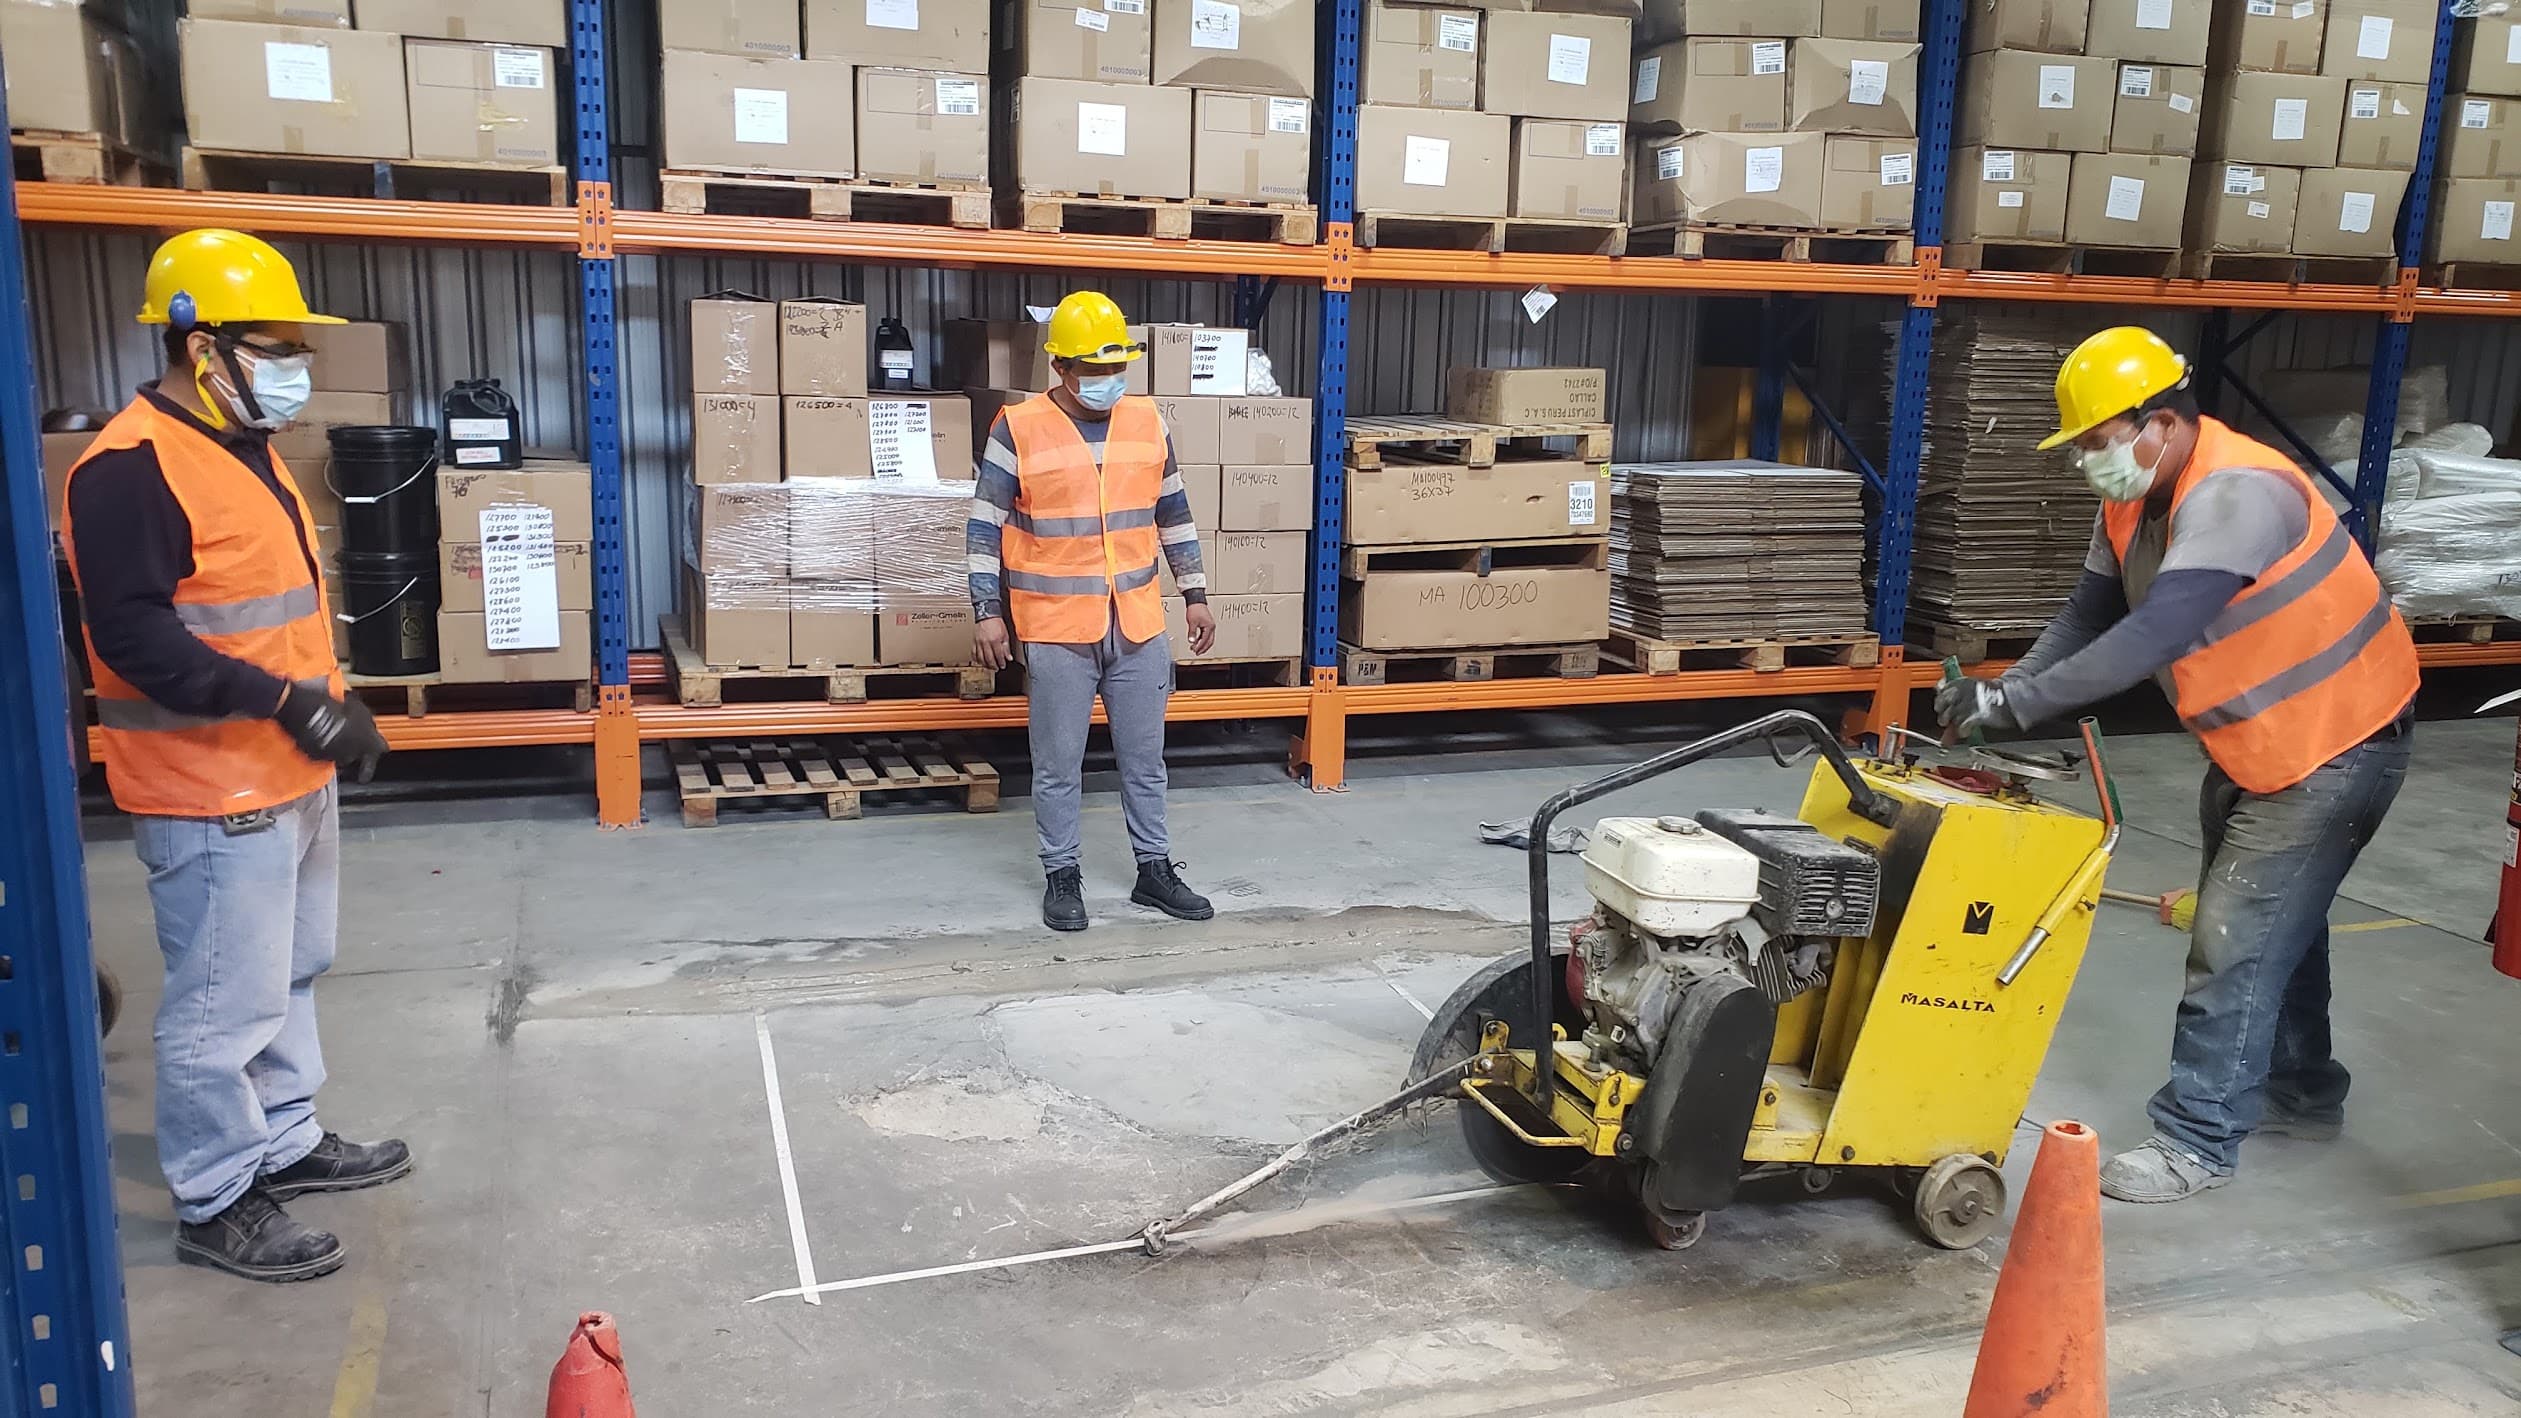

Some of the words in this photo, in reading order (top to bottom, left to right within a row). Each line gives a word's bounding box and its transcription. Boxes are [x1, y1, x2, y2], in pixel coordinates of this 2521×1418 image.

[1569, 392, 1597, 403] CALLAO
[1570, 498, 1593, 510] 3210
[1419, 586, 1446, 607] MA
[1459, 580, 1538, 611] 100300
[1900, 992, 1996, 1013] MASALTA
